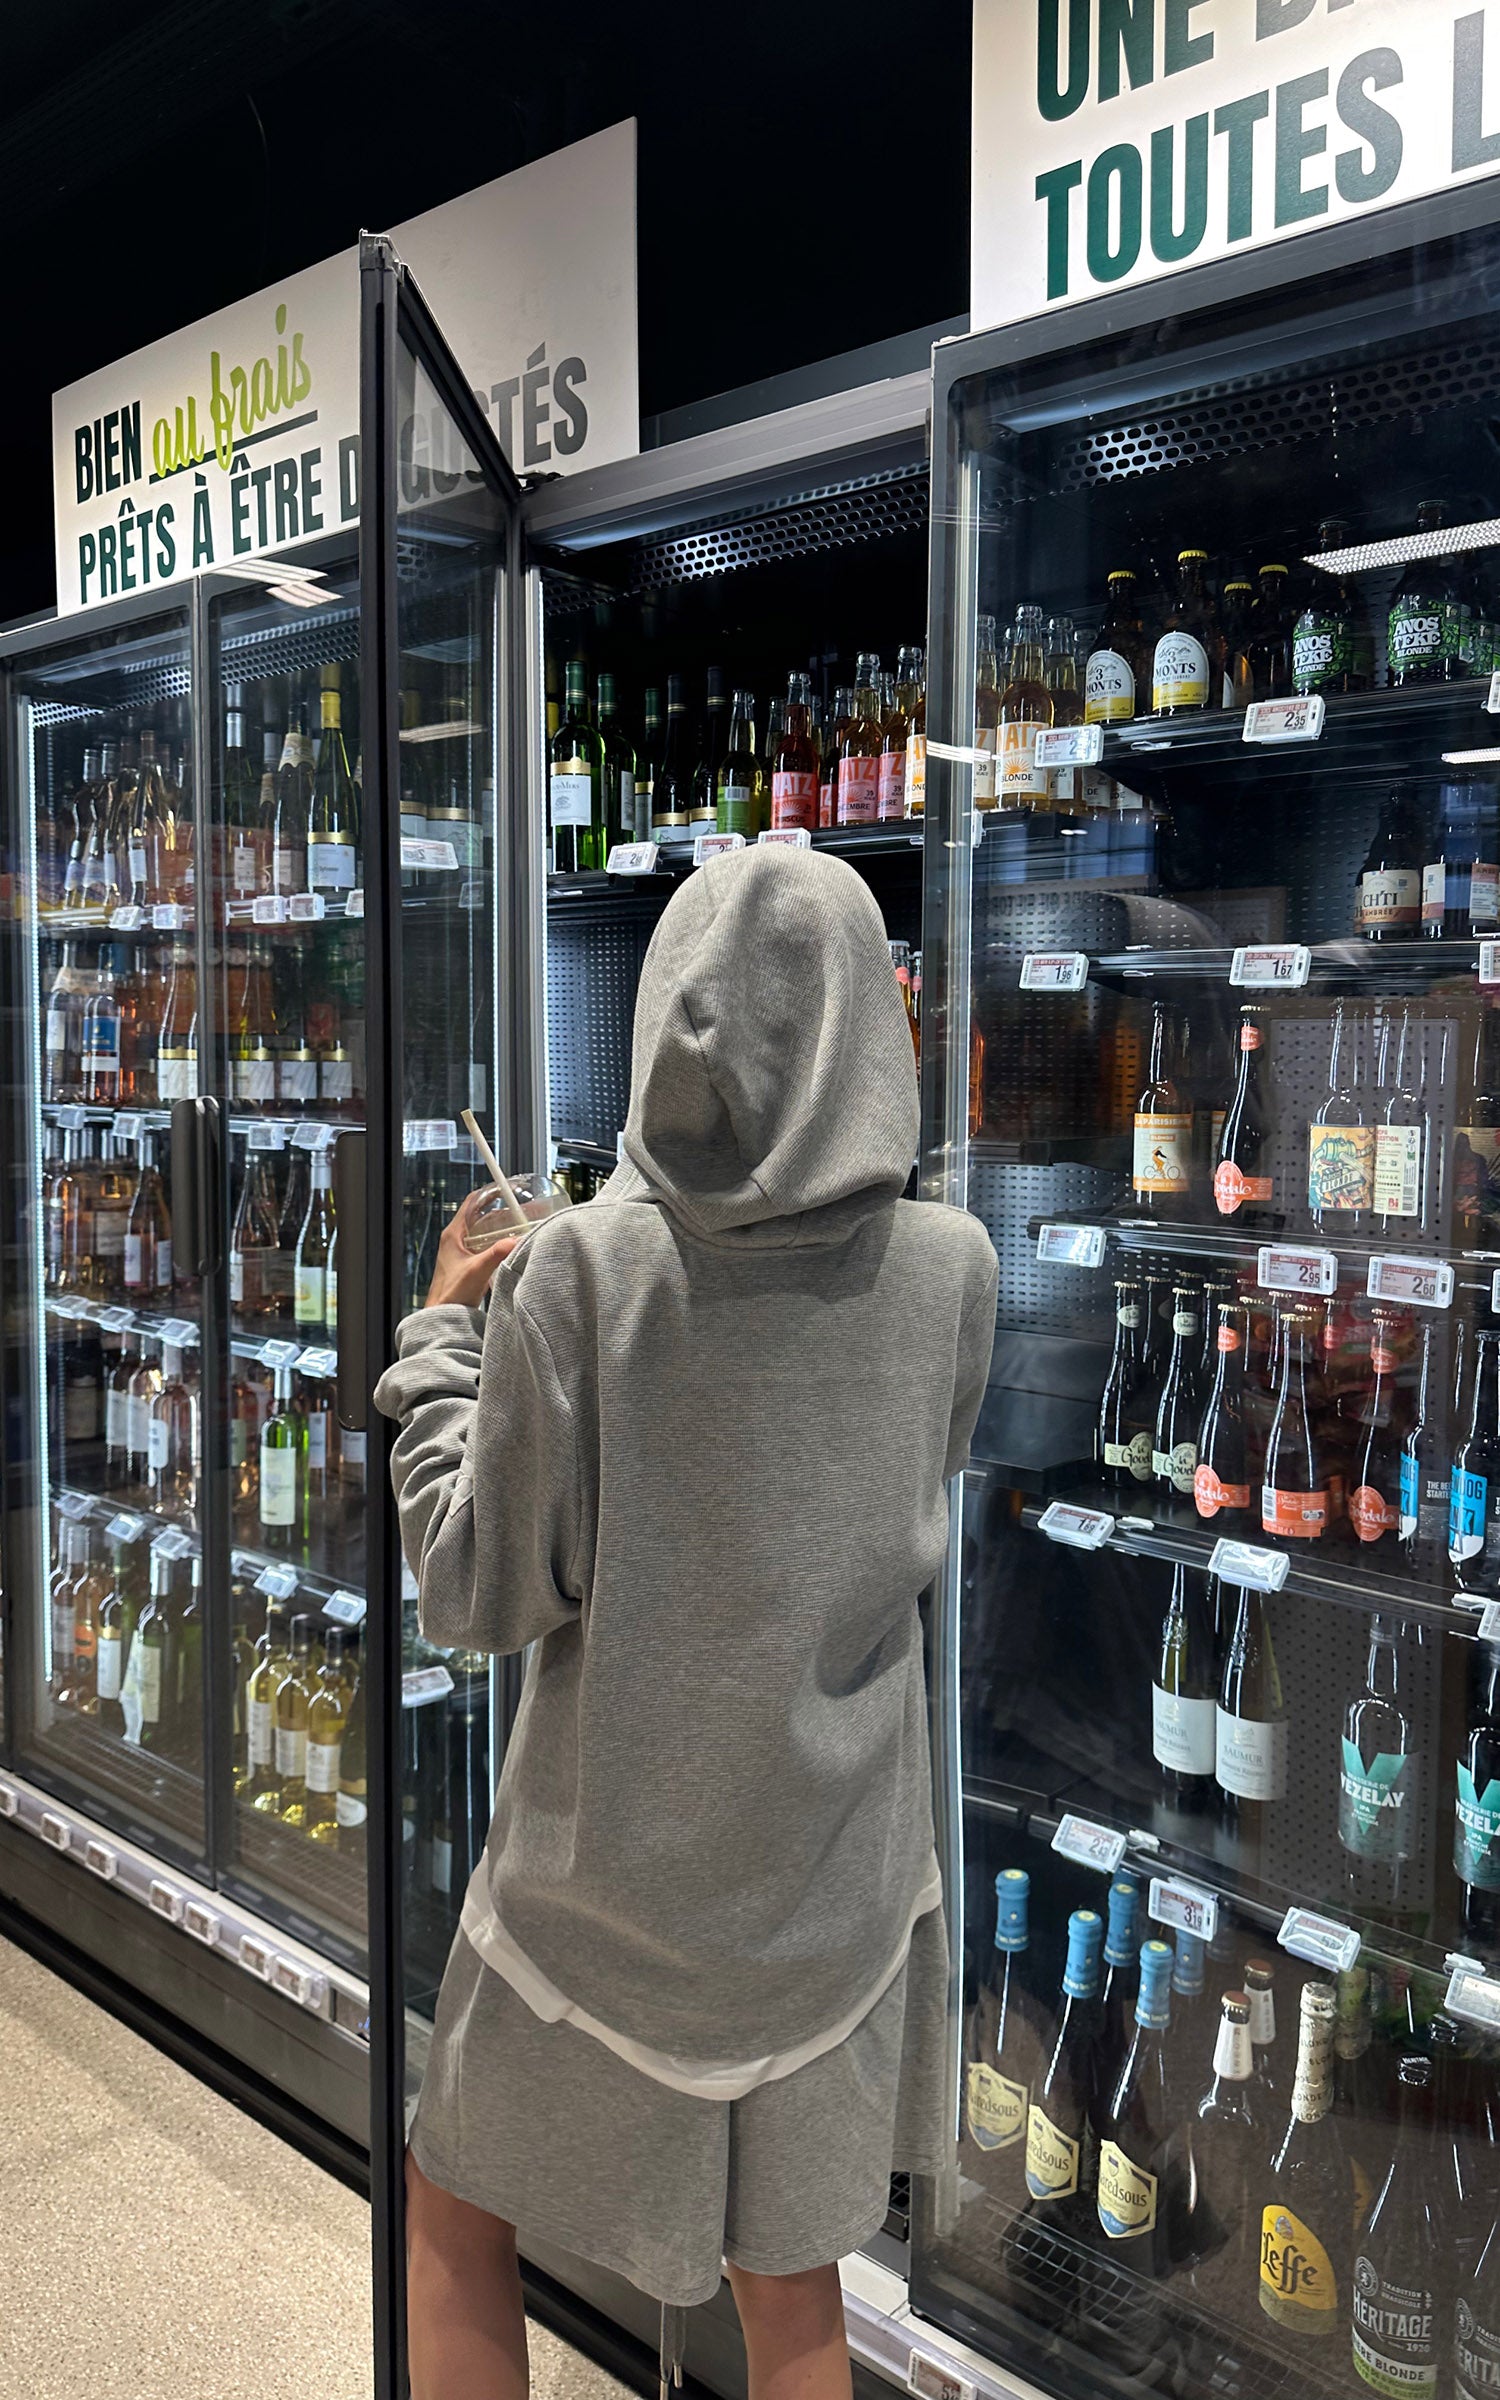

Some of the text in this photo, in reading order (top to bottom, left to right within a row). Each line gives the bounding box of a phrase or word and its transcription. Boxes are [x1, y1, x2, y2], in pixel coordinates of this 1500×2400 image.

[1037, 0, 1215, 123] UNE
[1035, 47, 1404, 302] TOUTES
[75, 303, 311, 505] BIEN au frais
[79, 340, 588, 605] PRÊTS À ÊTRE DGUSTÉS
[1395, 615, 1440, 636] ANOS
[1293, 634, 1332, 651] ANOS
[1393, 631, 1442, 648] TEKE
[1167, 651, 1177, 664] 3
[1293, 650, 1333, 668] TEKE
[1396, 646, 1433, 658] BLONDE
[1095, 667, 1104, 681] 3
[1155, 662, 1196, 677] MONTS
[1295, 663, 1326, 675] BLONDE
[1087, 678, 1122, 694] MONTS
[1121, 1447, 1151, 1467] Goud
[1163, 1456, 1196, 1477] Goud
[1426, 1480, 1439, 1490] THE
[1426, 1490, 1450, 1499] STARTE
[1223, 1745, 1263, 1763] SAUMUR
[1340, 1771, 1405, 1808] VEZELAY
[972, 2094, 1019, 2117] redsous
[1028, 2139, 1070, 2171] redsous
[1100, 2175, 1148, 2208] aredsous
[1262, 2231, 1318, 2295] Leffe
[1382, 2281, 1422, 2298] TRADITION
[1353, 2284, 1433, 2341] HÉRITAGE
[1375, 2358, 1425, 2381] BLONDE
